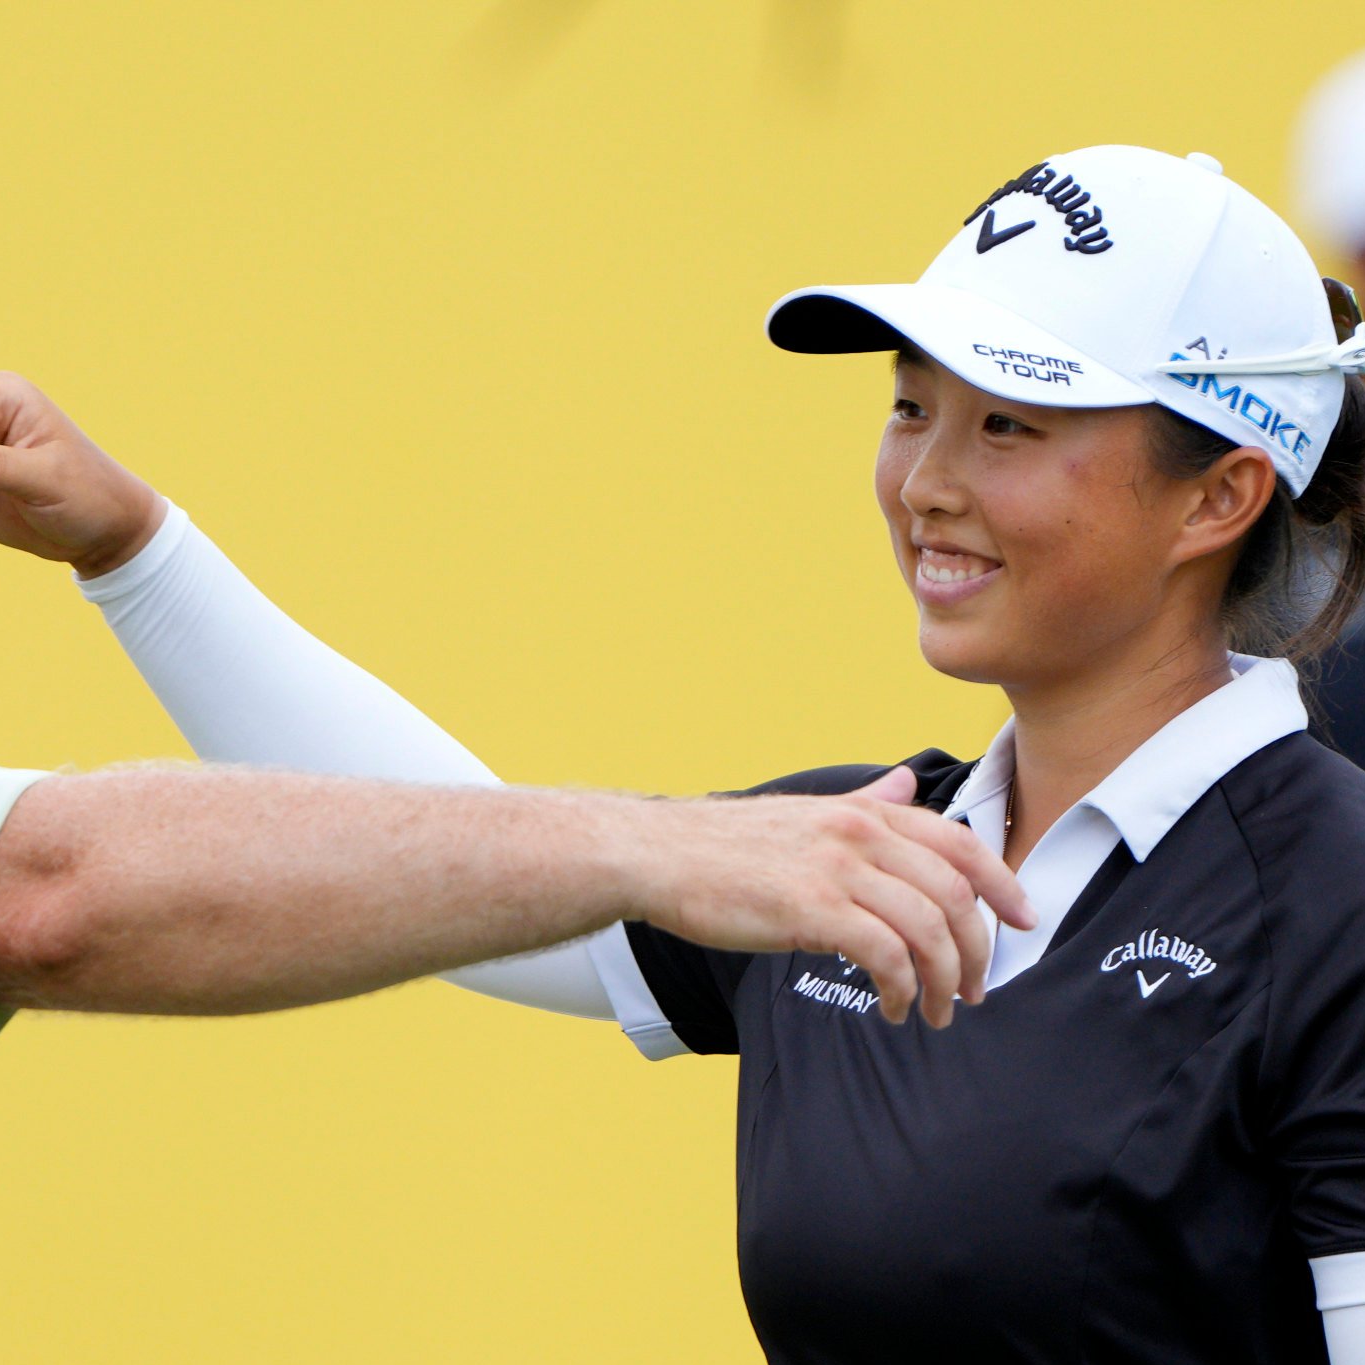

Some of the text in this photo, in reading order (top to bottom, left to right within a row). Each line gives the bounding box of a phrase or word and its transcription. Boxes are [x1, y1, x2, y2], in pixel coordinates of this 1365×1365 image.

[972, 343, 1085, 375] CHROME
[994, 360, 1072, 387] TOUR
[1100, 928, 1217, 979] Callaway
[793, 971, 880, 1014] MILKYWAY
